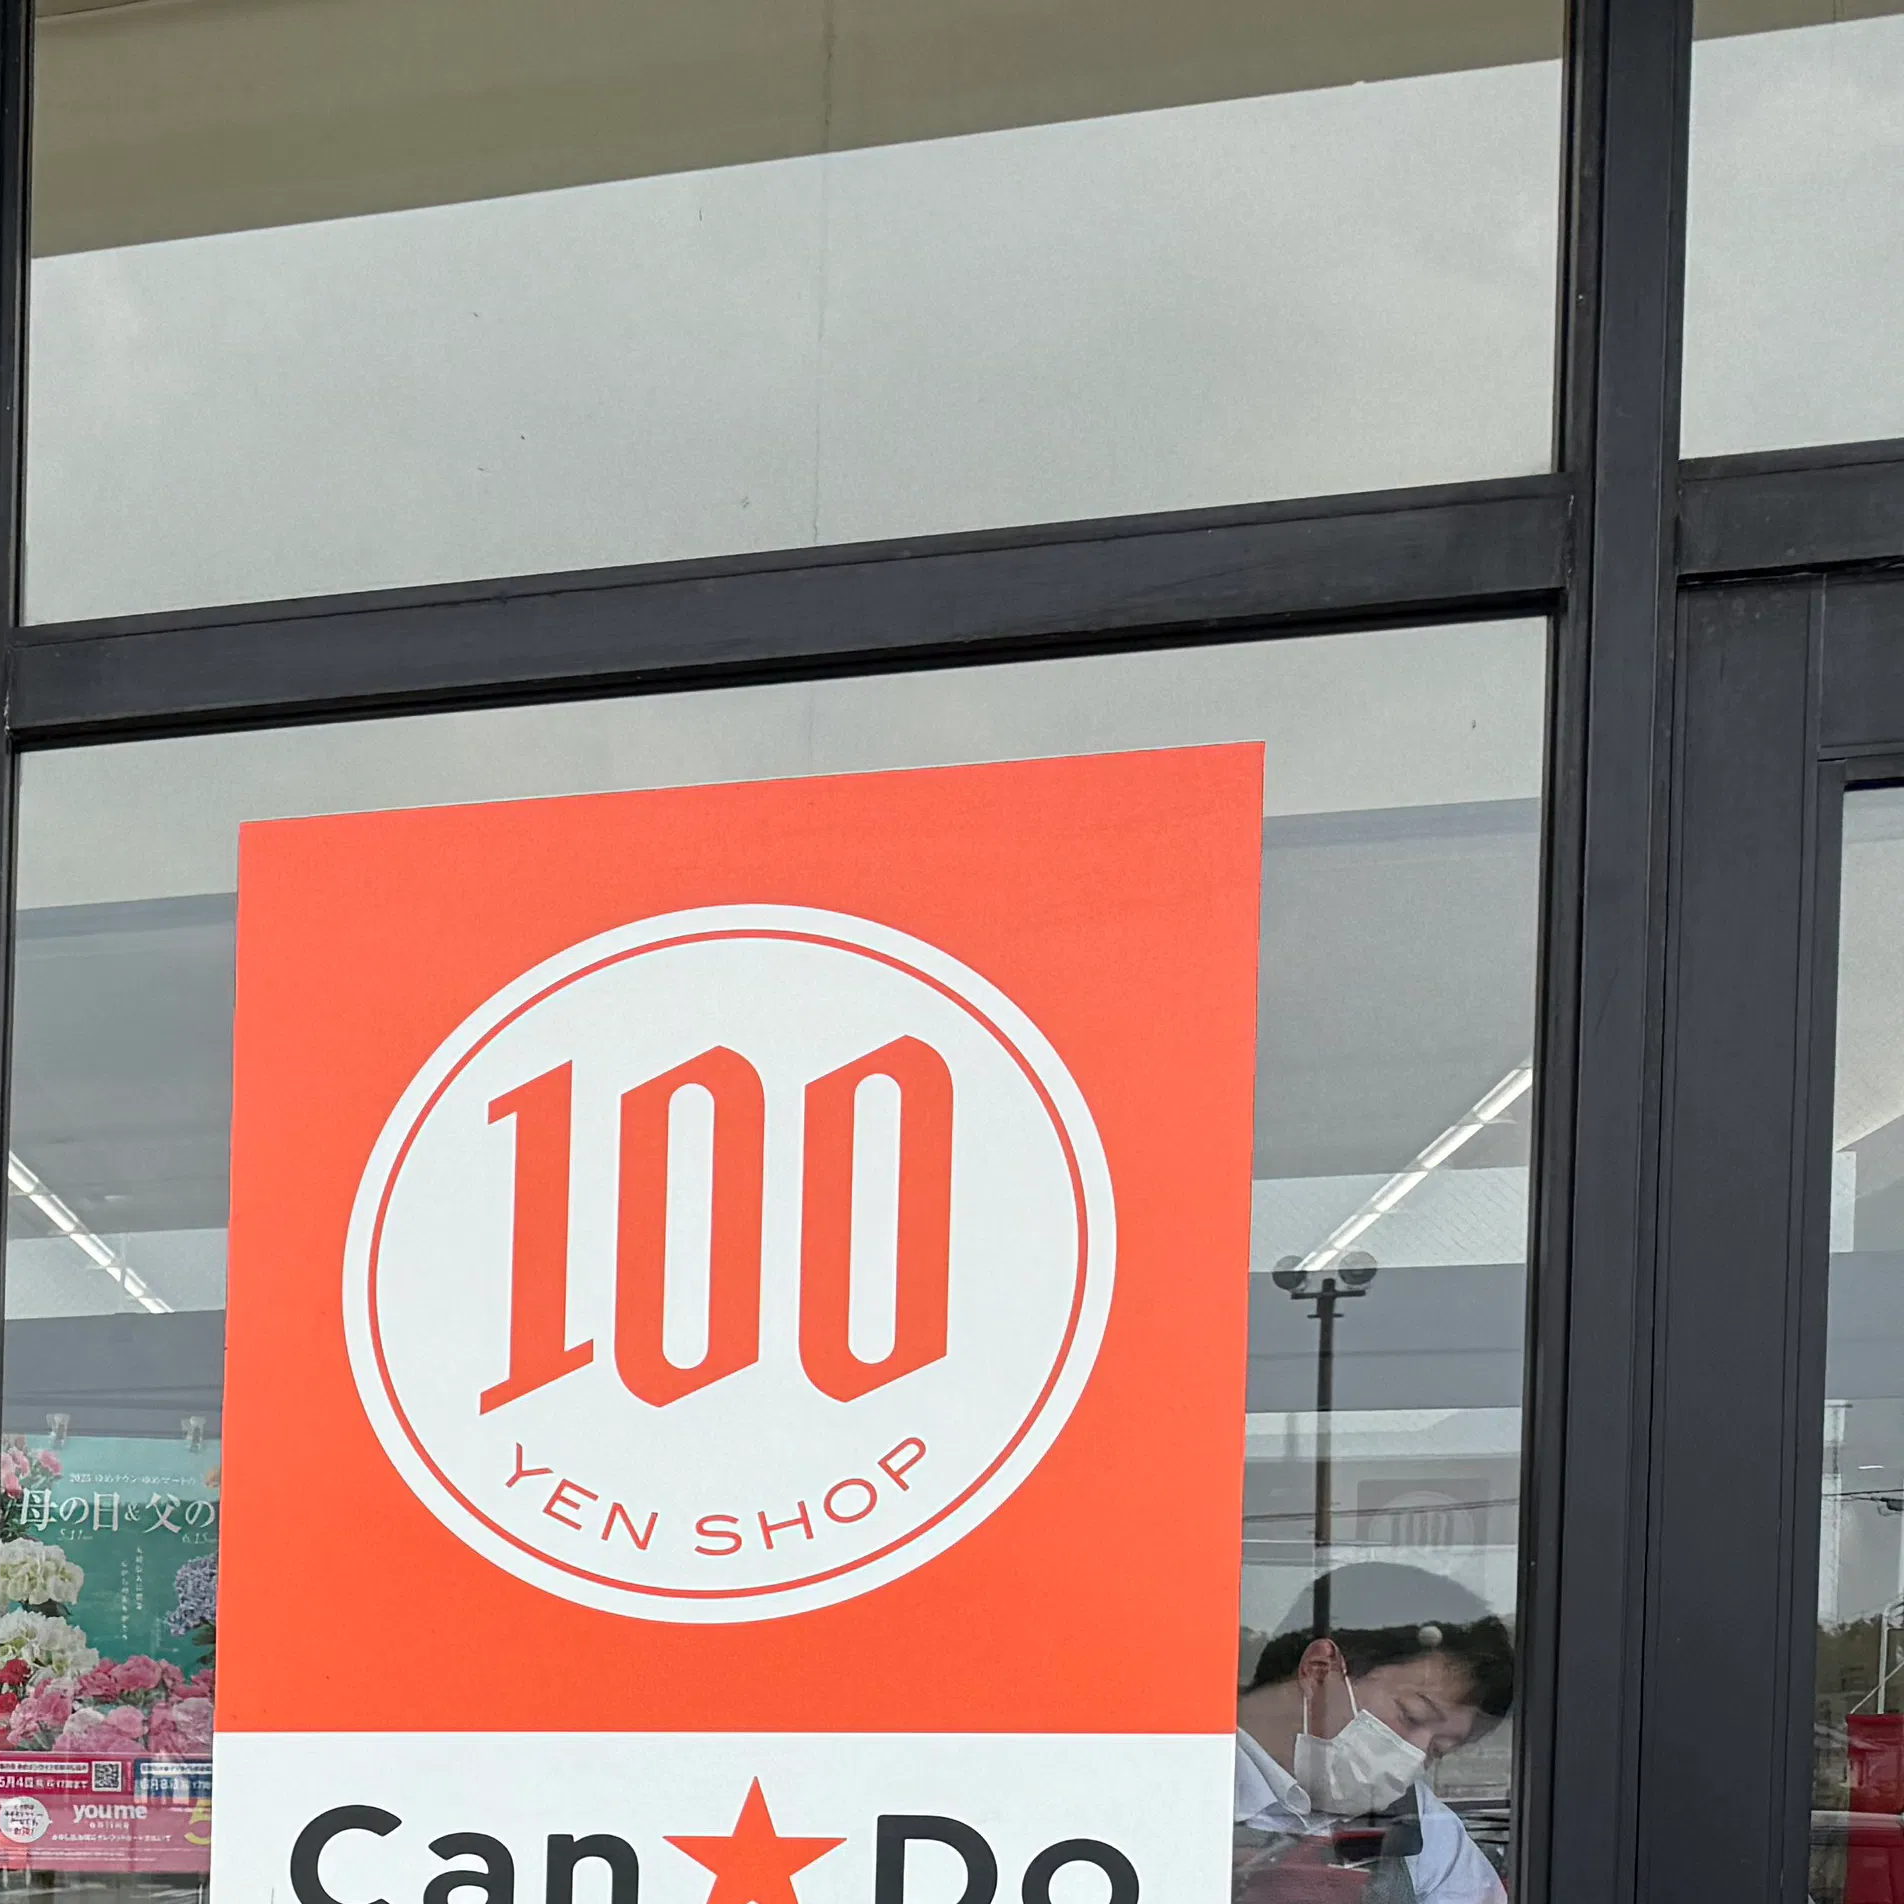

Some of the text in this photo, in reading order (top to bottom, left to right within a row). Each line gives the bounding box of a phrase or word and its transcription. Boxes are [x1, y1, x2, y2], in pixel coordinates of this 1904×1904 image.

[480, 1033, 955, 1416] 100
[502, 1434, 930, 1560] YEN SHOP
[73, 1804, 148, 1823] youme
